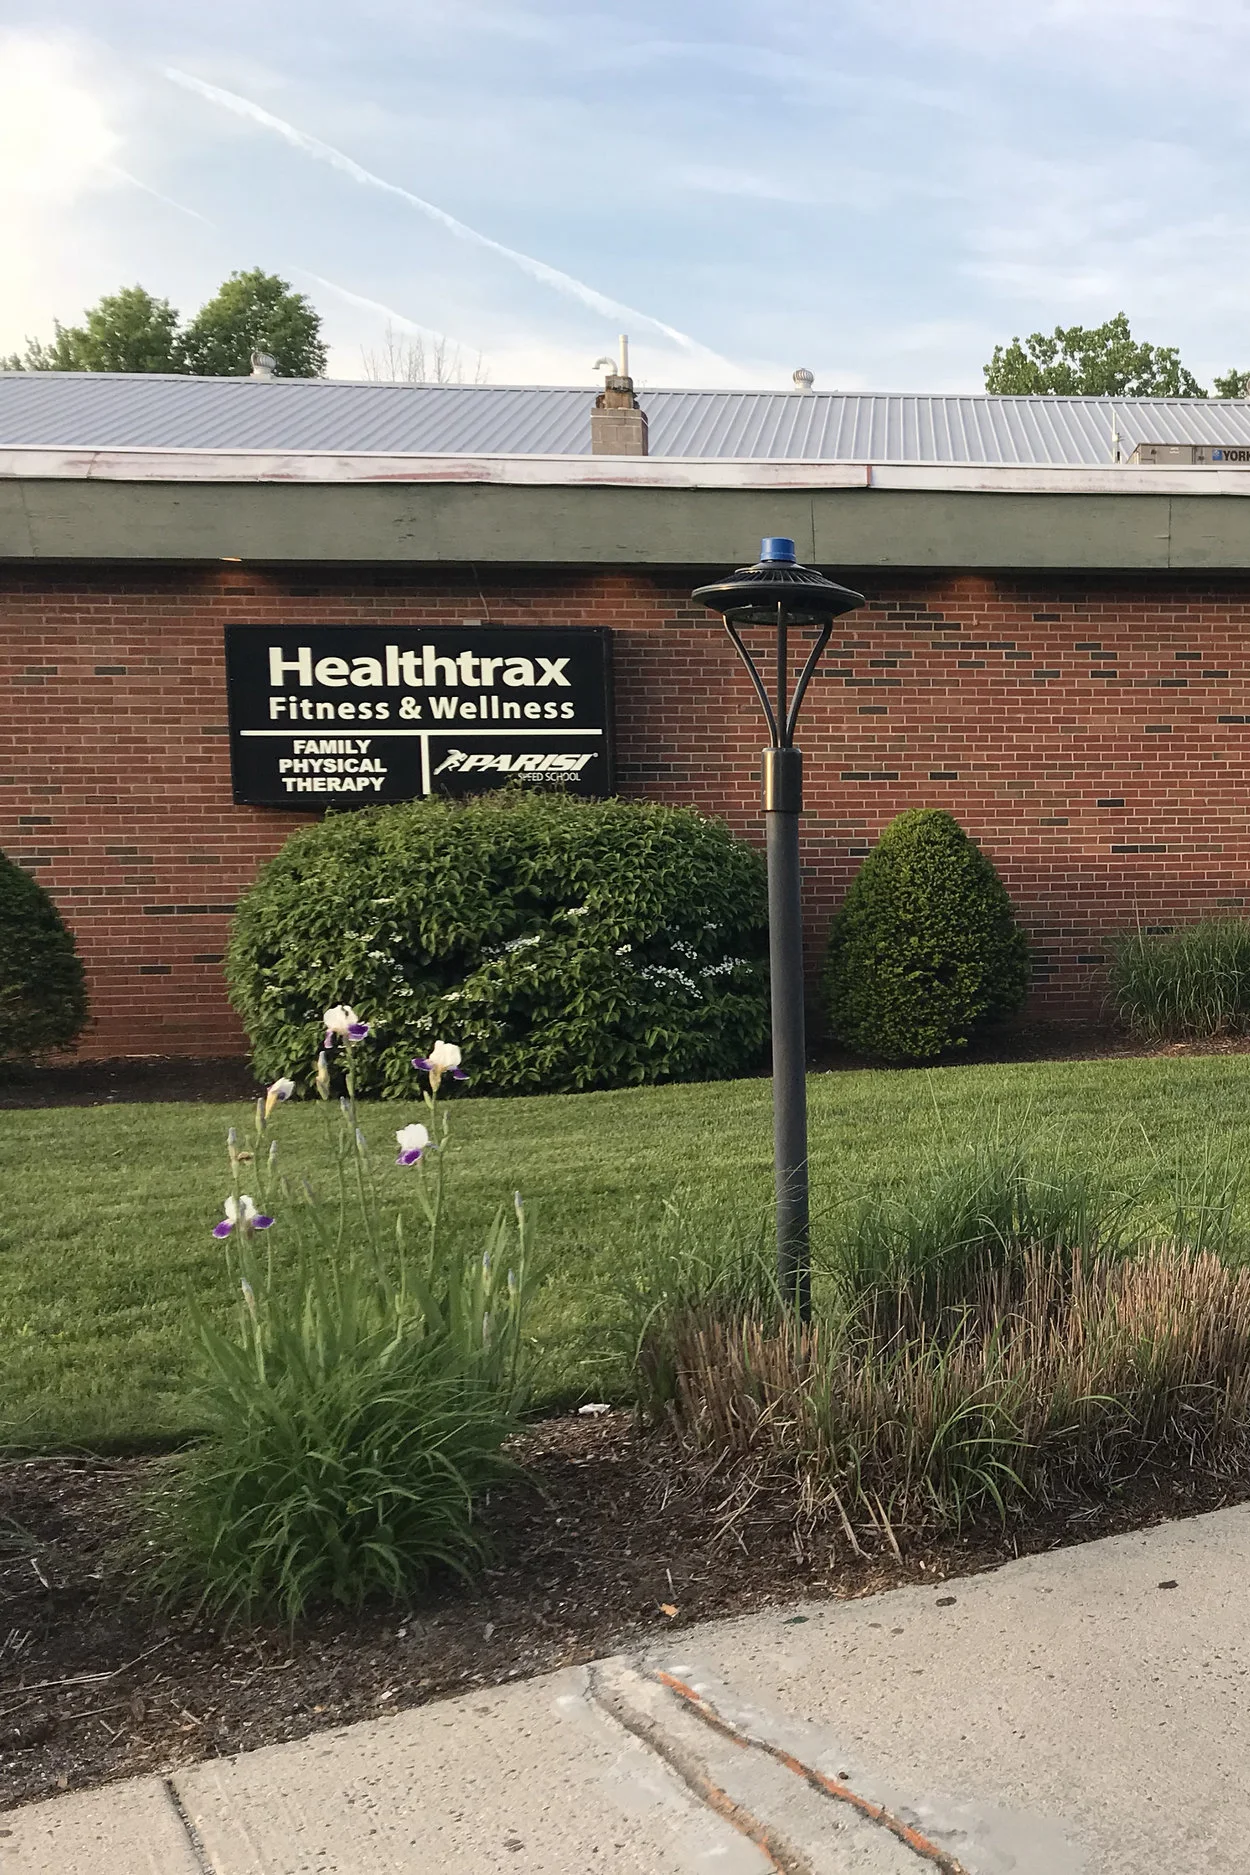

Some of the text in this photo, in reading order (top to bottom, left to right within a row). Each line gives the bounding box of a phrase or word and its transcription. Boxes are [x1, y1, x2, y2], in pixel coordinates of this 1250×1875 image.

[268, 645, 572, 687] Healthtrax
[268, 695, 576, 720] Fitness & Wellness
[292, 739, 372, 755] FAMILY
[278, 758, 388, 774] PHYSICAL
[457, 753, 594, 772] PARISI
[281, 776, 386, 792] THERAPY
[545, 772, 582, 782] SCHOOL
